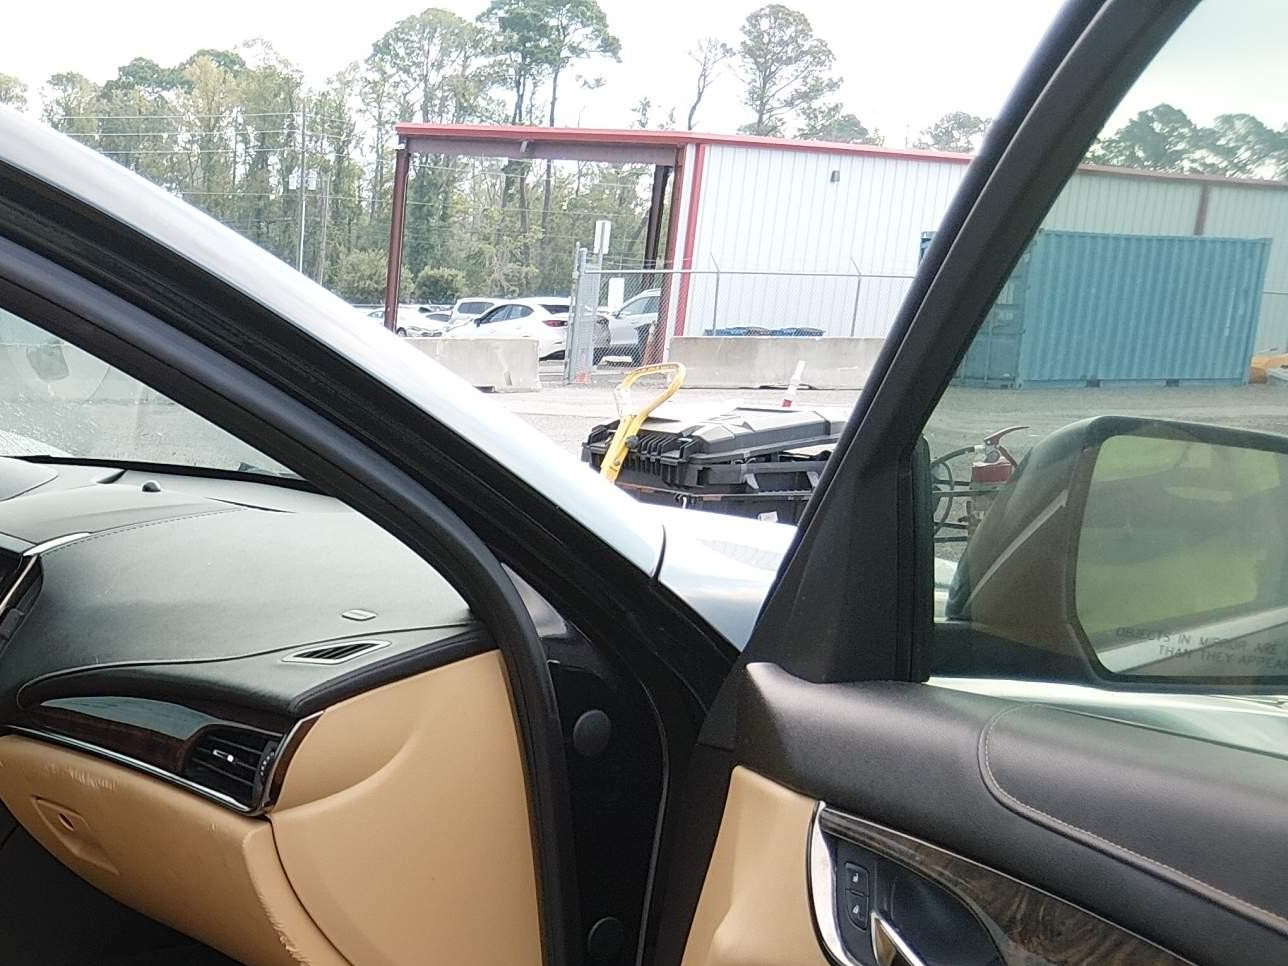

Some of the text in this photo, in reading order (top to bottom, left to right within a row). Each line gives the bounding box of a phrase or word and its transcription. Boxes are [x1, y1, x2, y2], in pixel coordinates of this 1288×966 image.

[1115, 627, 1170, 643] OBJECTS
[1178, 634, 1191, 646] IN
[1159, 645, 1193, 660] THAN
[1201, 651, 1234, 664] THEY
